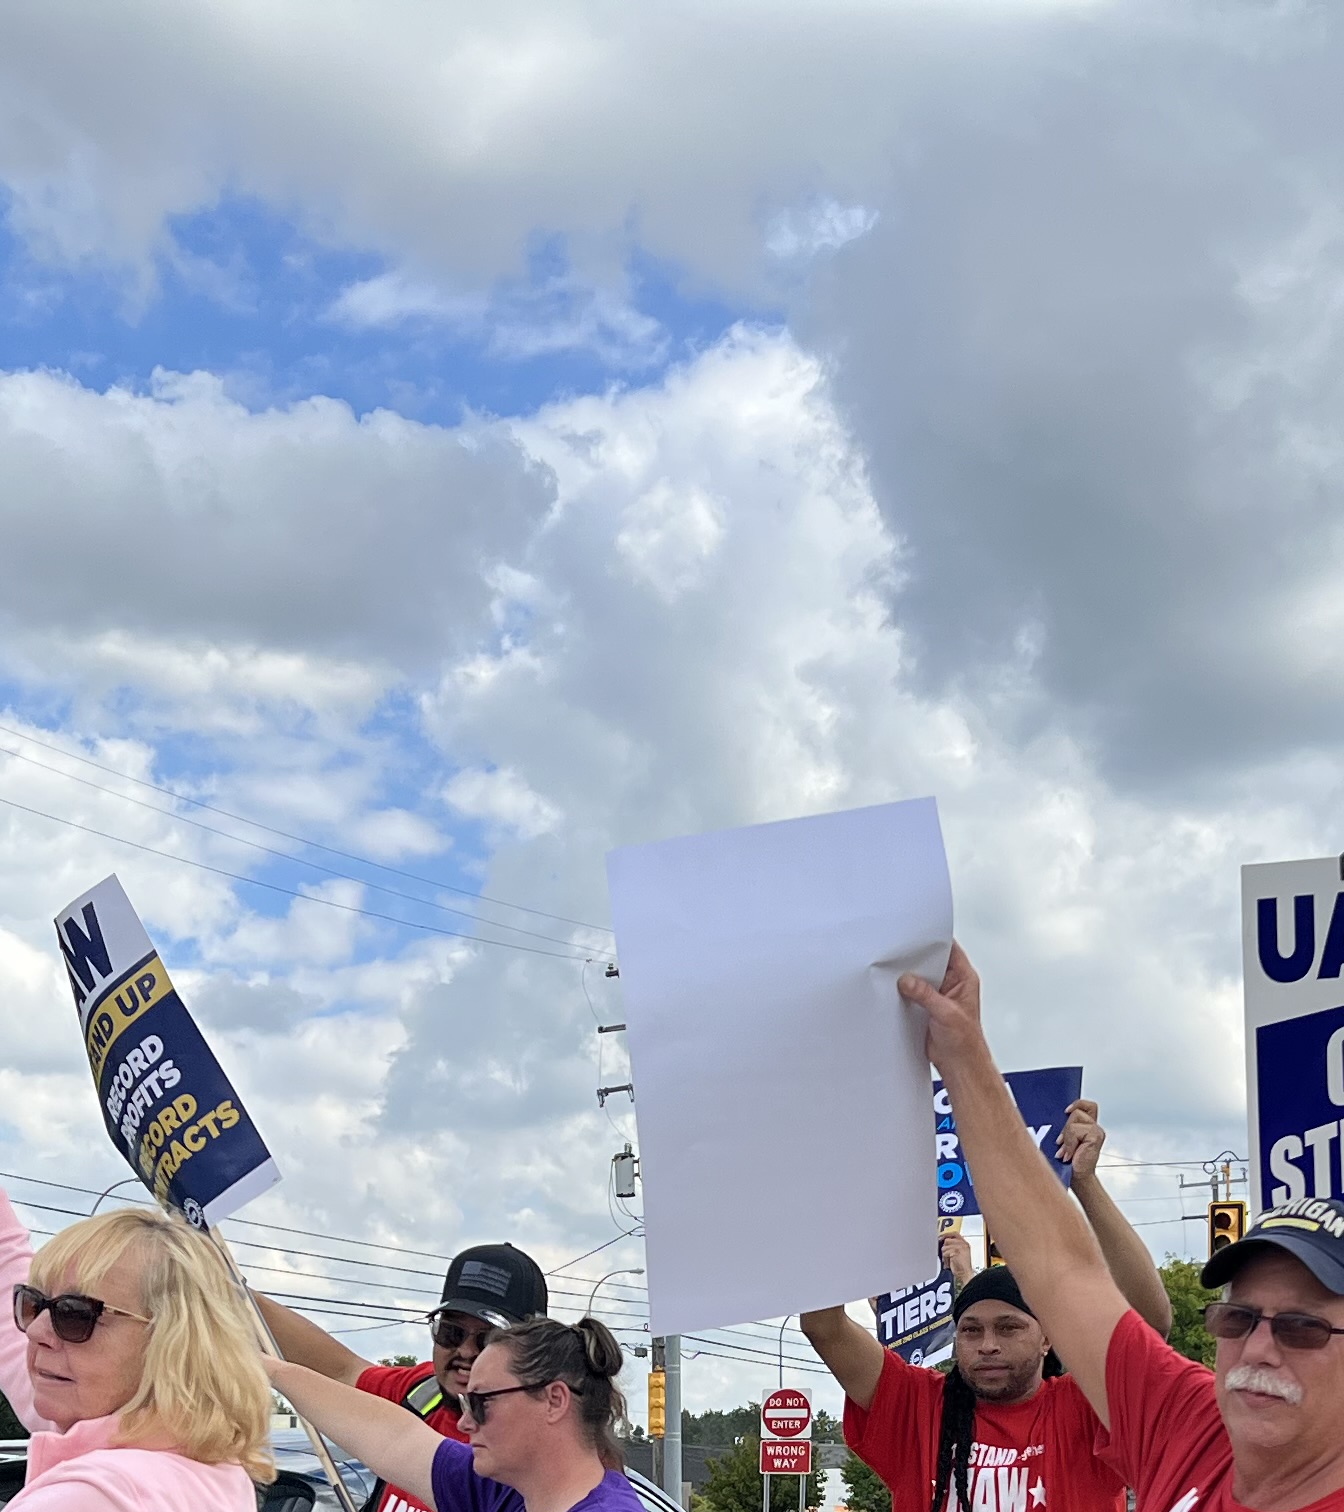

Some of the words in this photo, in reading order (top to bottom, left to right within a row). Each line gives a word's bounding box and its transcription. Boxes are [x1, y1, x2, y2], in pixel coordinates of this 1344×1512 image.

[114, 972, 157, 1018] UP
[106, 1034, 165, 1125] RECORD
[120, 1059, 182, 1149] PROFITS
[138, 1093, 198, 1180] RECORD
[880, 1281, 953, 1340] TIERS
[769, 1398, 782, 1407] DO
[786, 1397, 805, 1407] NOT
[771, 1420, 801, 1429] ENTER
[766, 1445, 806, 1456] WRONG
[773, 1458, 798, 1469] WAY
[967, 1442, 1018, 1467] STAND
